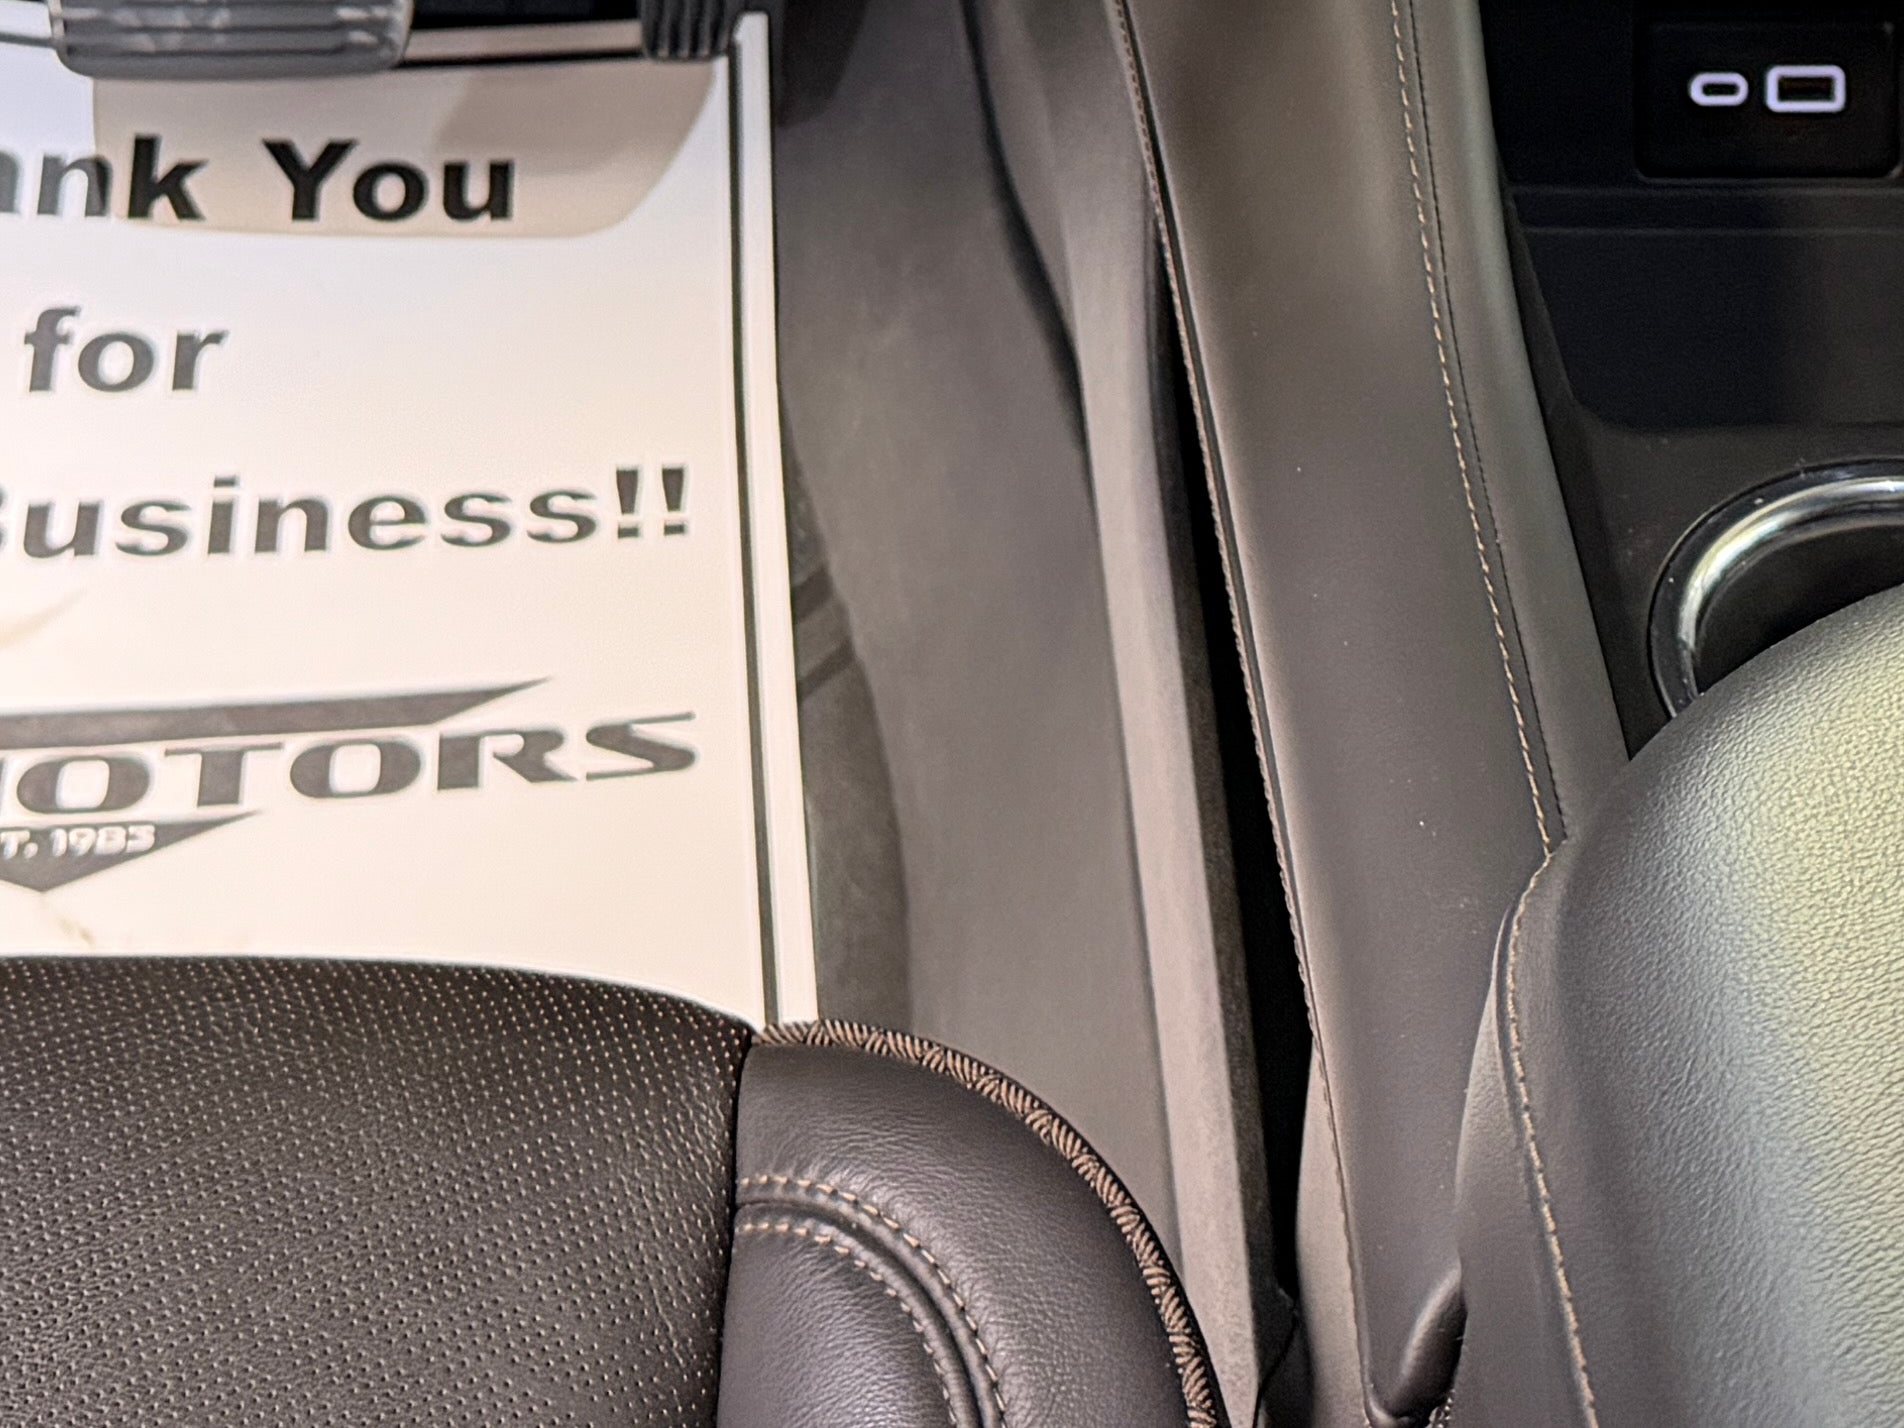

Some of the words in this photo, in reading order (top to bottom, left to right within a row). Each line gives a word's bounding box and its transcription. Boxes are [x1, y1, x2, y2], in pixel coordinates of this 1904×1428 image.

[259, 138, 515, 227] You
[22, 305, 228, 396] for
[49, 823, 156, 857] 1983
